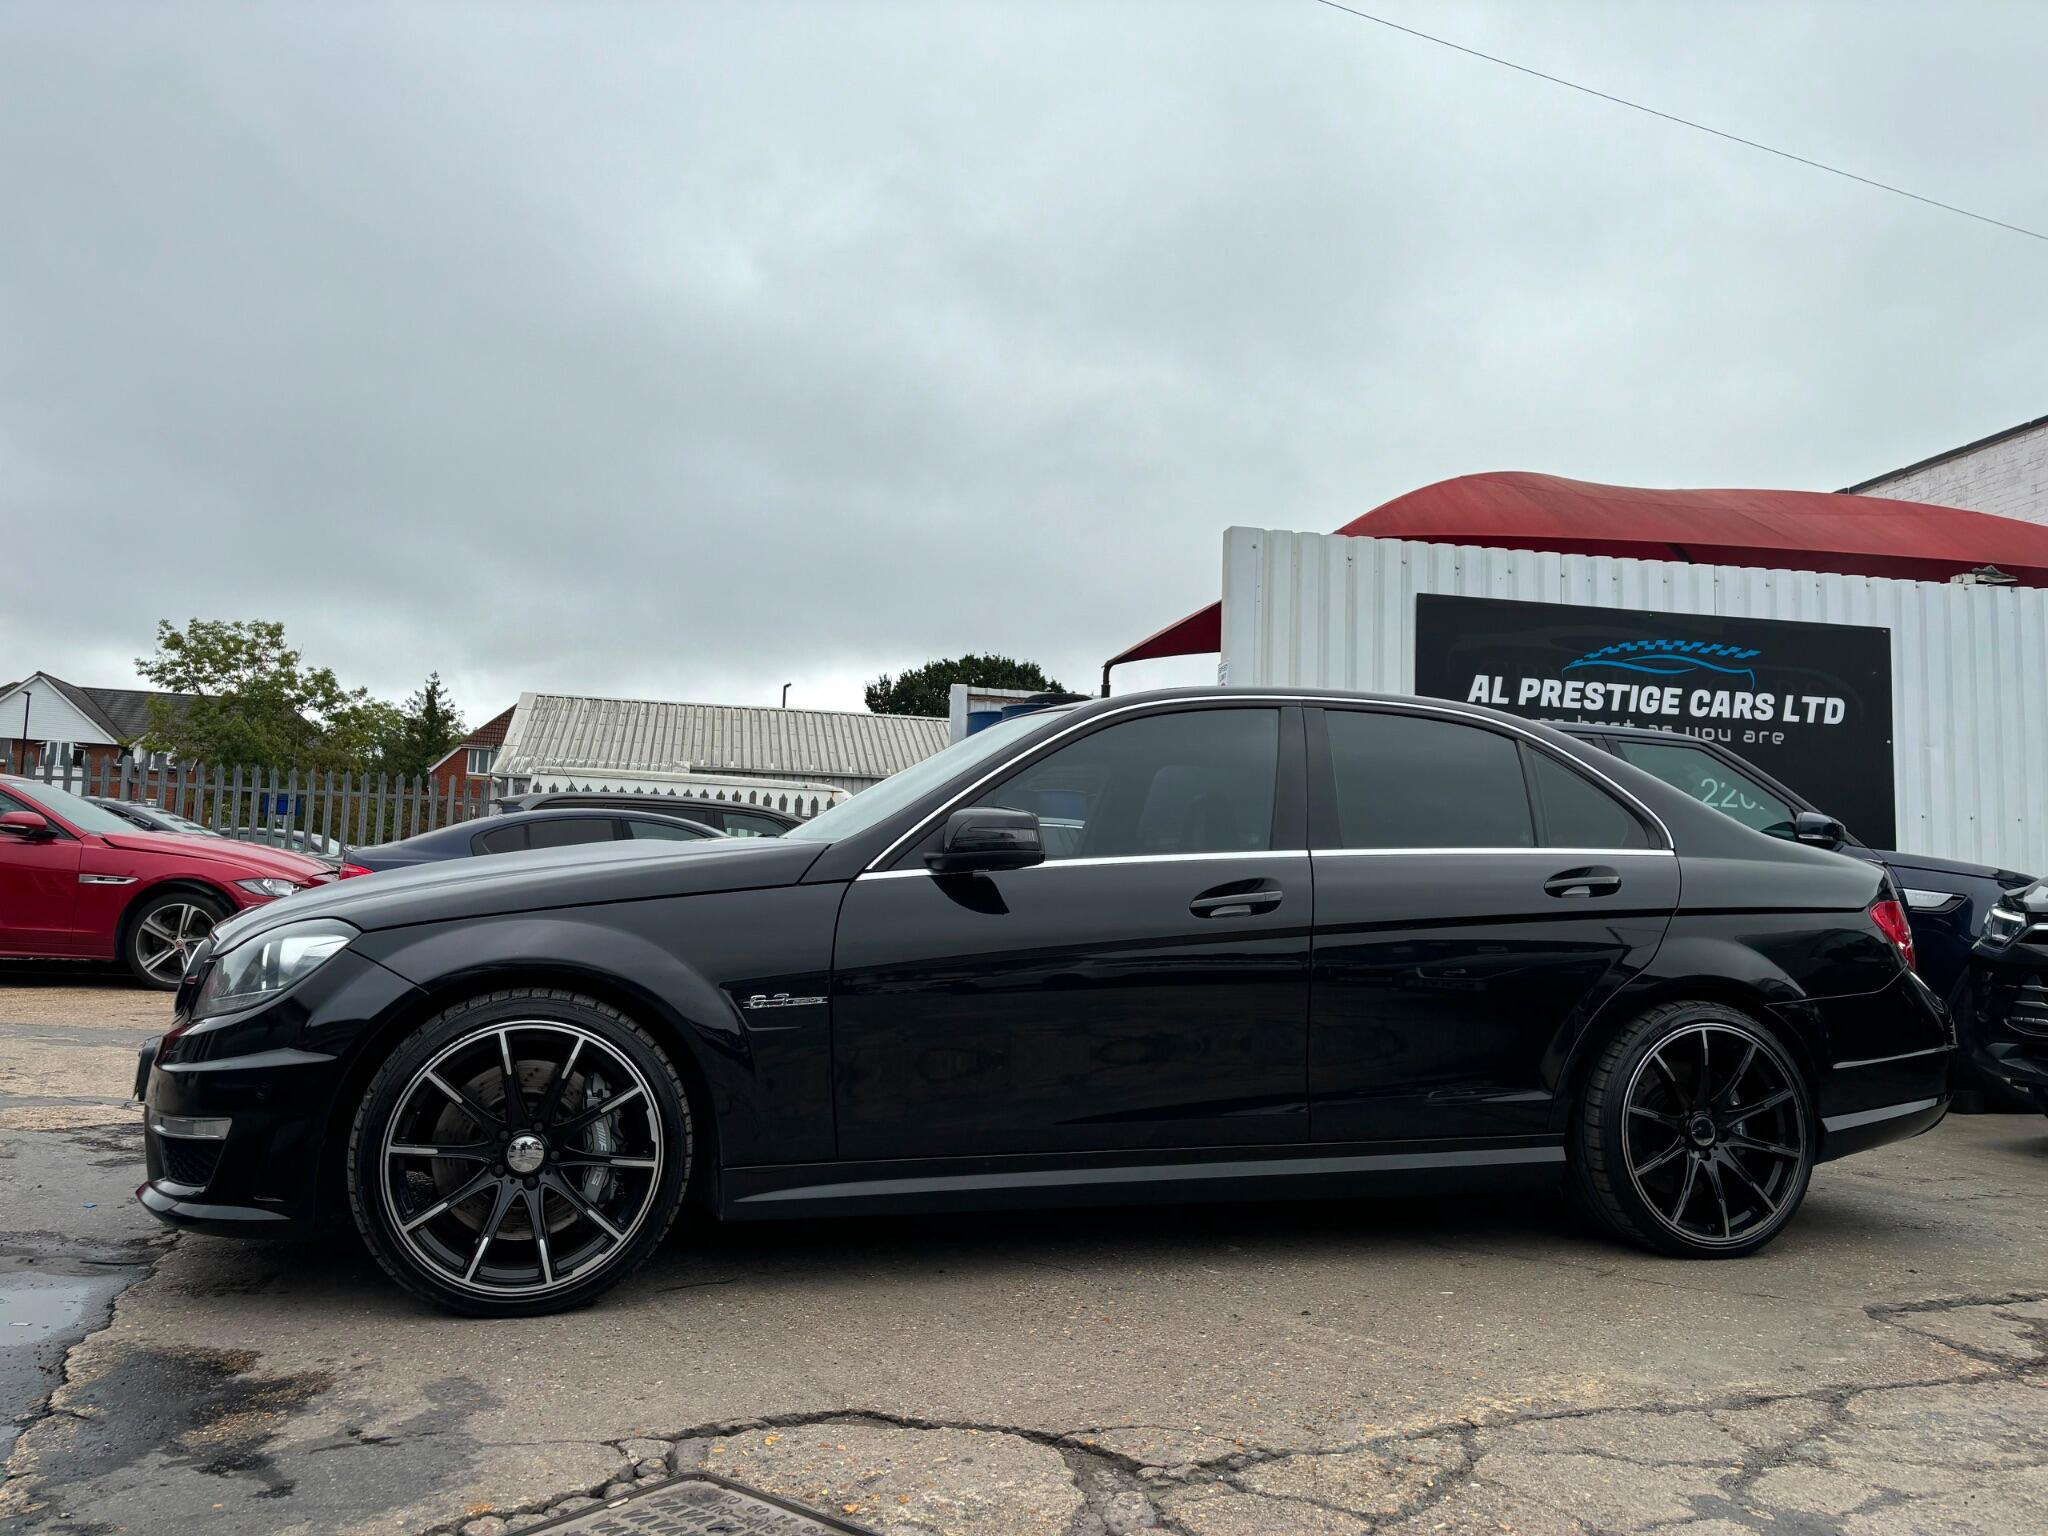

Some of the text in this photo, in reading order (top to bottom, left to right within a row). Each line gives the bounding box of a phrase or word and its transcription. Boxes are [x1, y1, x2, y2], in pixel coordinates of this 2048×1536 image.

[1467, 674, 1846, 725] AL PRESTIGE CARS LTD
[1743, 729, 1785, 745] are
